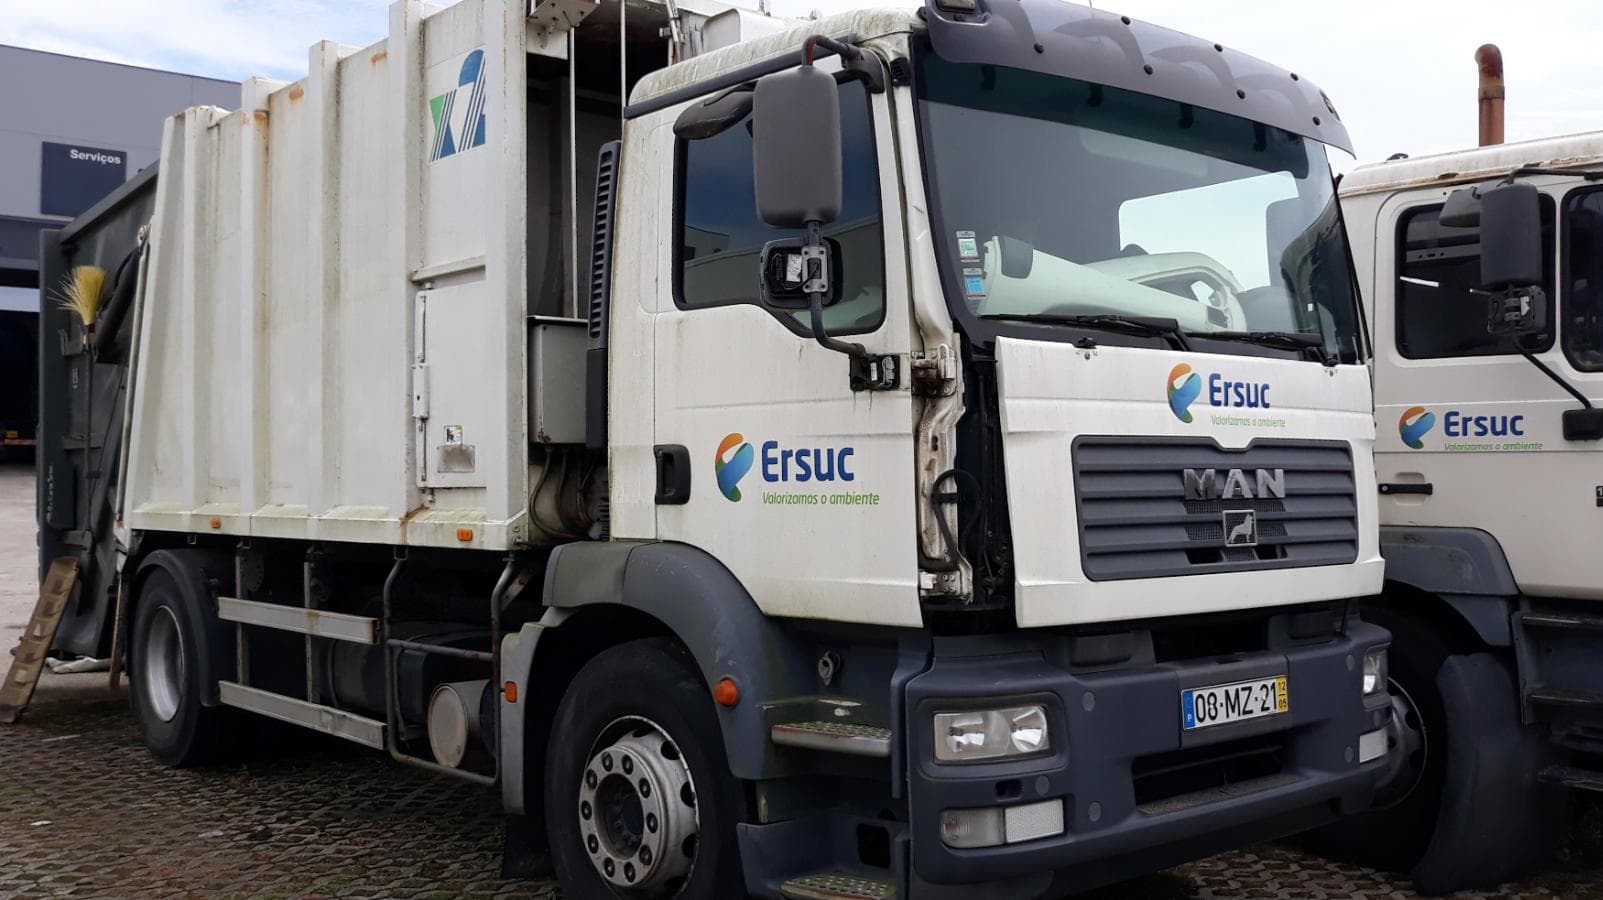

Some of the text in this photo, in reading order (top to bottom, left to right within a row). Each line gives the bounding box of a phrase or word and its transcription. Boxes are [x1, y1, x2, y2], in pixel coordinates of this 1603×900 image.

[70, 148, 121, 165] Serviços
[1209, 373, 1270, 409] Ersuc
[1444, 410, 1524, 437] Ersuc
[1444, 442, 1493, 451] Valorizamos
[1503, 441, 1543, 450] ambiente
[761, 440, 855, 482] Ersuc
[1183, 468, 1286, 499] MAN
[762, 491, 880, 505] Valorizamos o ambiente
